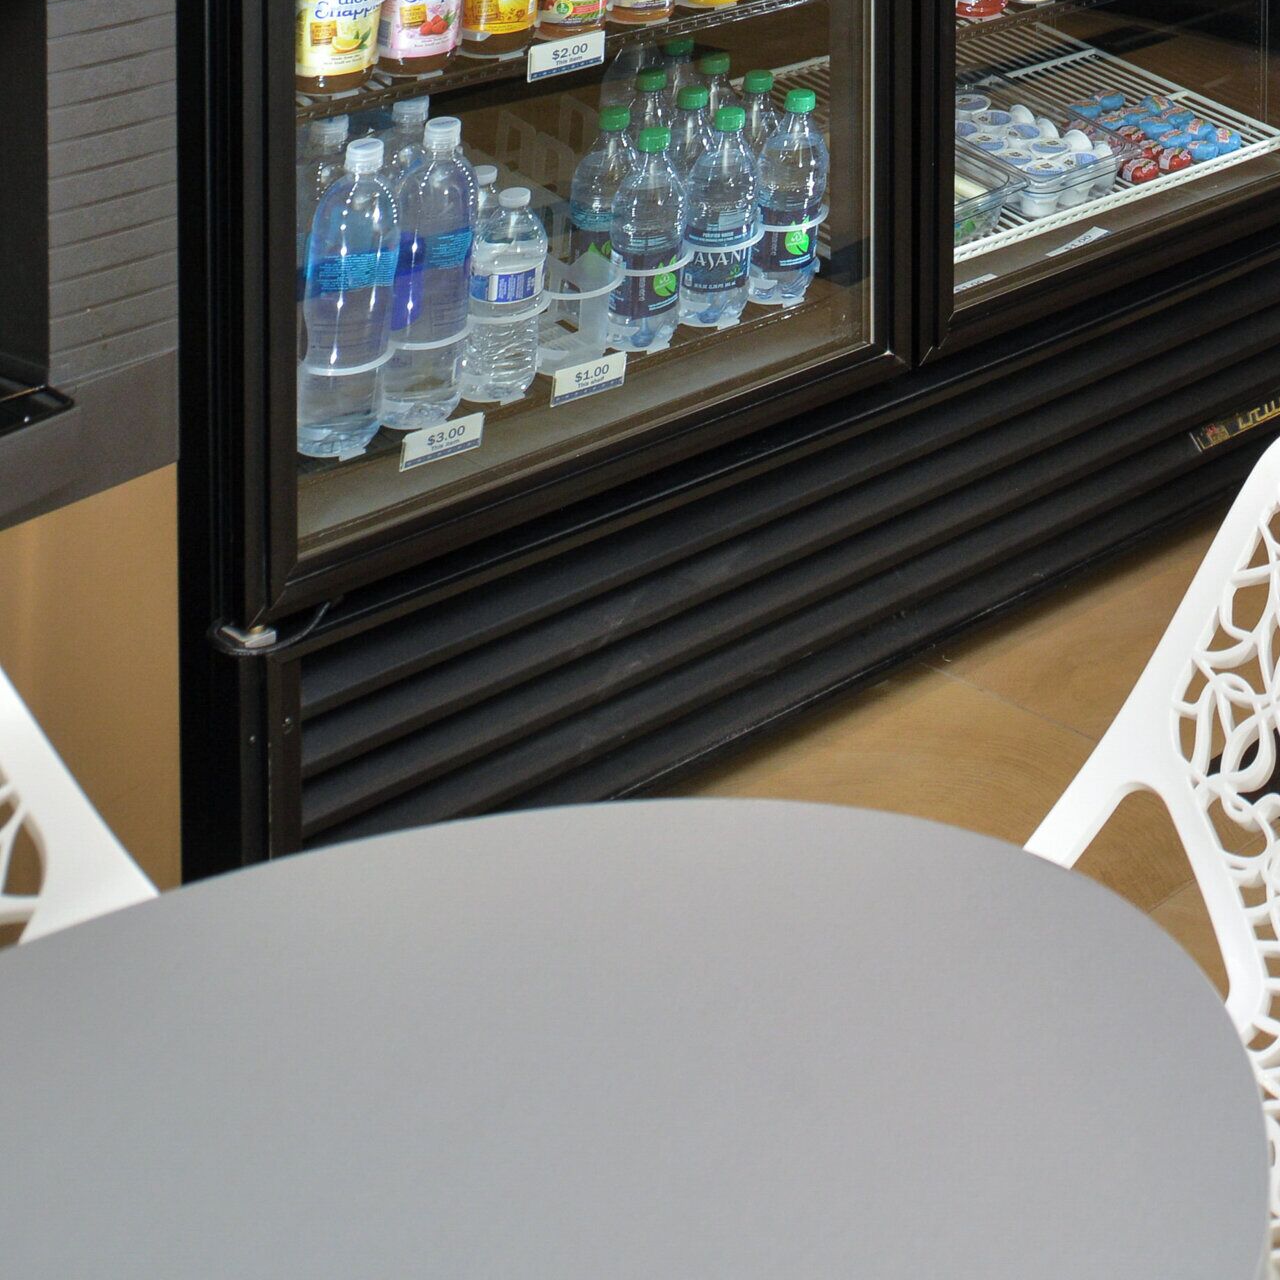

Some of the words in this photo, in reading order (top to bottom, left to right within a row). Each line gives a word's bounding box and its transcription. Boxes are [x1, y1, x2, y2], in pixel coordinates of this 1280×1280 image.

[552, 43, 588, 60] $2.00
[555, 58, 568, 66] This
[569, 55, 582, 63] item
[574, 363, 609, 382] $1.00
[577, 380, 590, 389] This
[427, 425, 466, 446] $3.00
[430, 443, 443, 451] This
[445, 439, 460, 448] item
